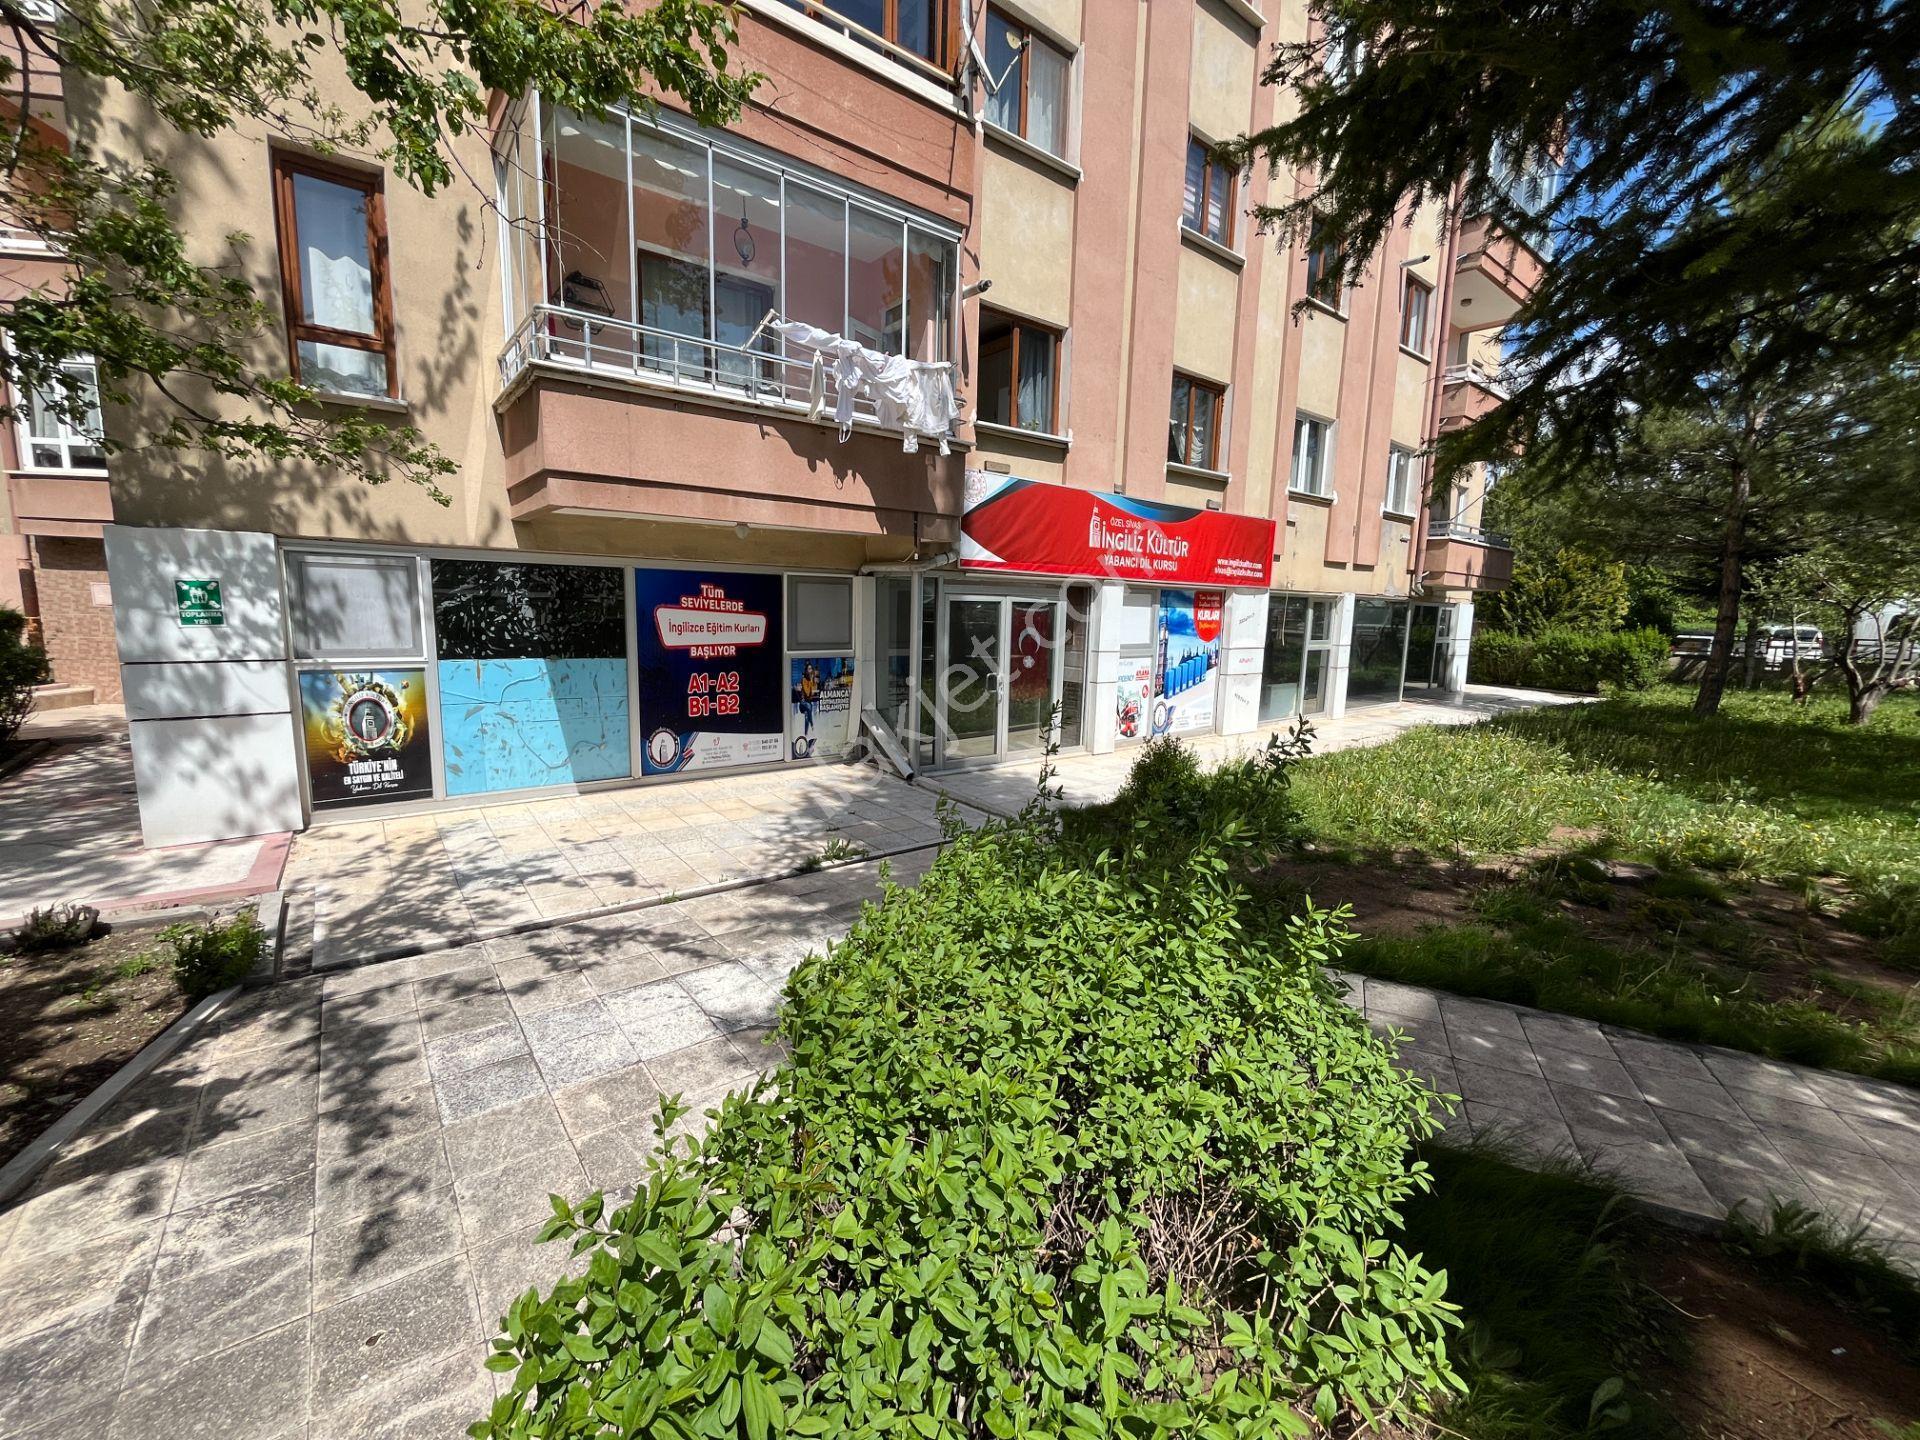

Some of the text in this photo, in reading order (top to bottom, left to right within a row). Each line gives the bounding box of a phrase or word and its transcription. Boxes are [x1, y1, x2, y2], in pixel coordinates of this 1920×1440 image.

[1110, 517, 1142, 530] ÖZEL SİVAS
[1101, 521, 1189, 557] İNGİLİZ KÜLTÜR
[1103, 554, 1178, 571] YABANCI DİL KURSU
[701, 584, 725, 599] Tüm
[681, 596, 744, 612] SEVİYELERDE
[1197, 608, 1220, 621] KURLARI
[668, 618, 760, 636] İngilizce Eğitim Kurları
[690, 645, 736, 659] BAŞLIYOR
[688, 671, 740, 694] A1-A2
[819, 688, 849, 699] ALMANCA
[688, 693, 740, 717] B1-B2
[348, 757, 398, 775] TÜRKİYE'NİN
[373, 773, 381, 782] VE
